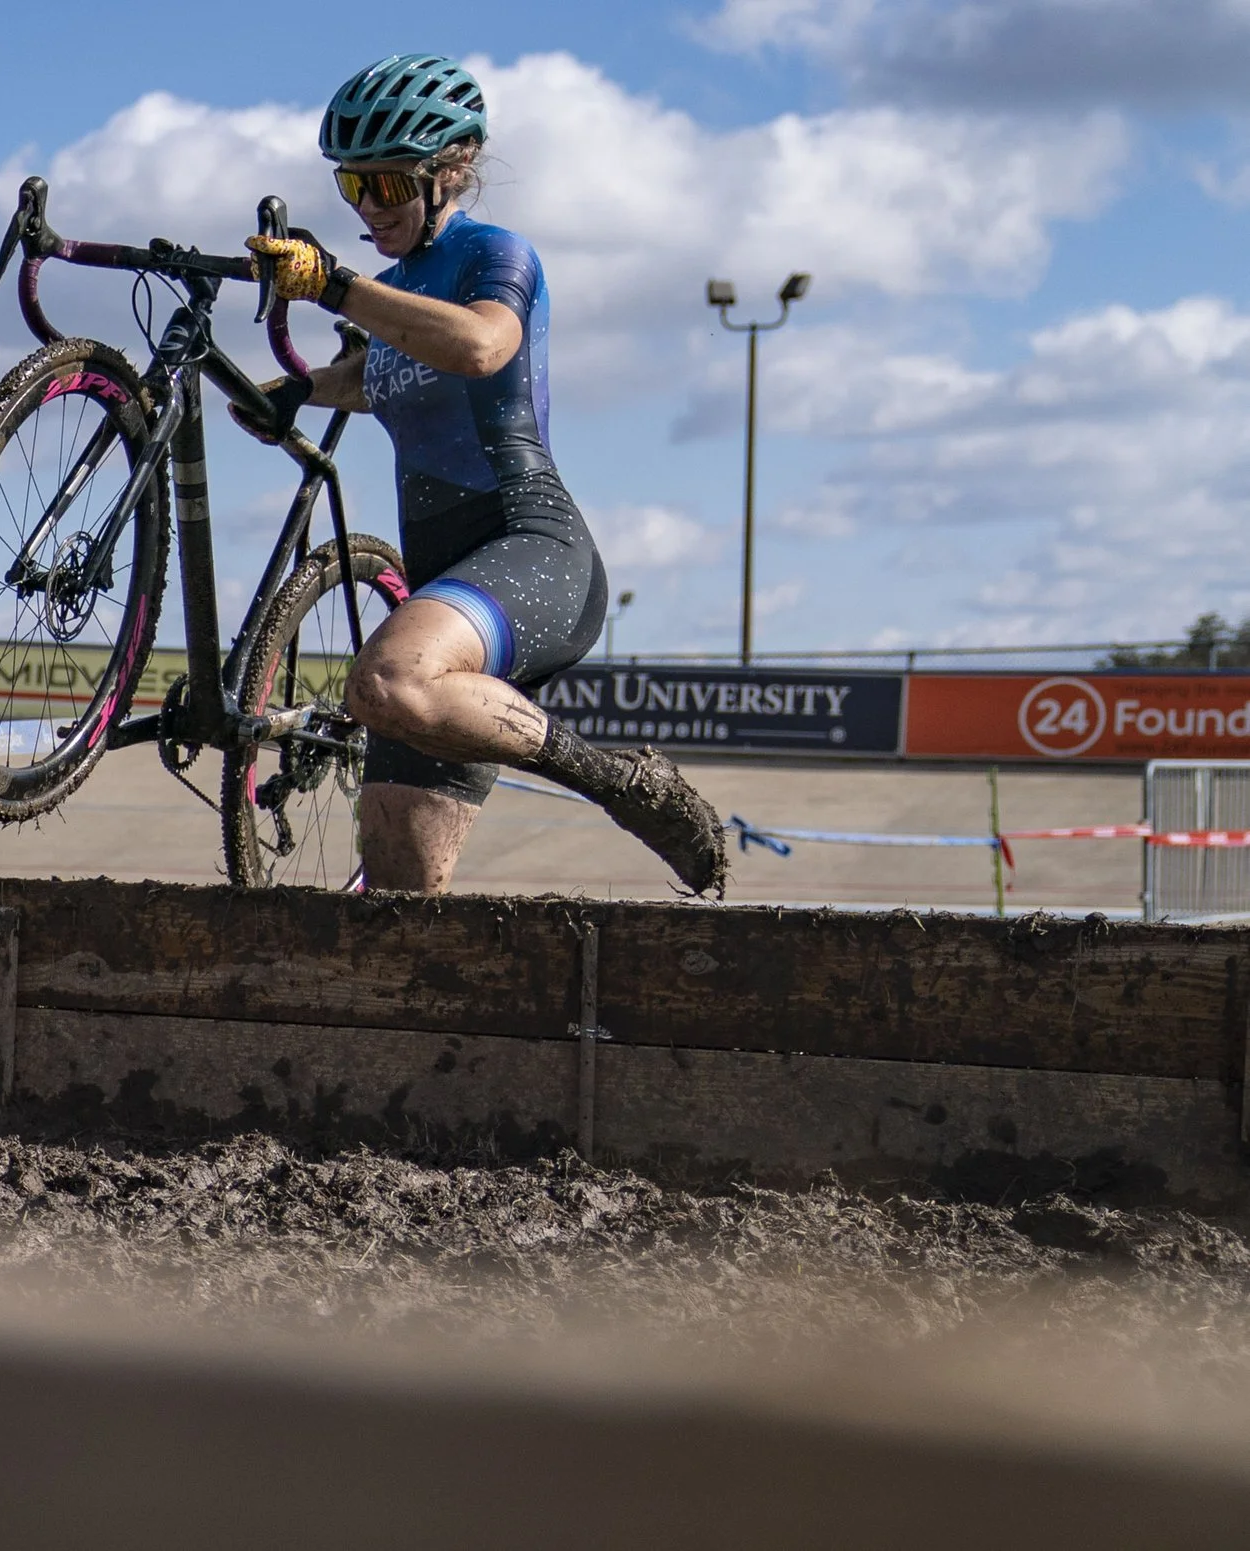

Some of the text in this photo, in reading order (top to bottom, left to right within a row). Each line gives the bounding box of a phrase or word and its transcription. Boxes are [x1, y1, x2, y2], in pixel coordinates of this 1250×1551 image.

[362, 363, 438, 409] SKAPE
[612, 672, 852, 717] UNIVERSITY
[553, 715, 730, 741] ndianapolis
[1033, 697, 1090, 736] 24
